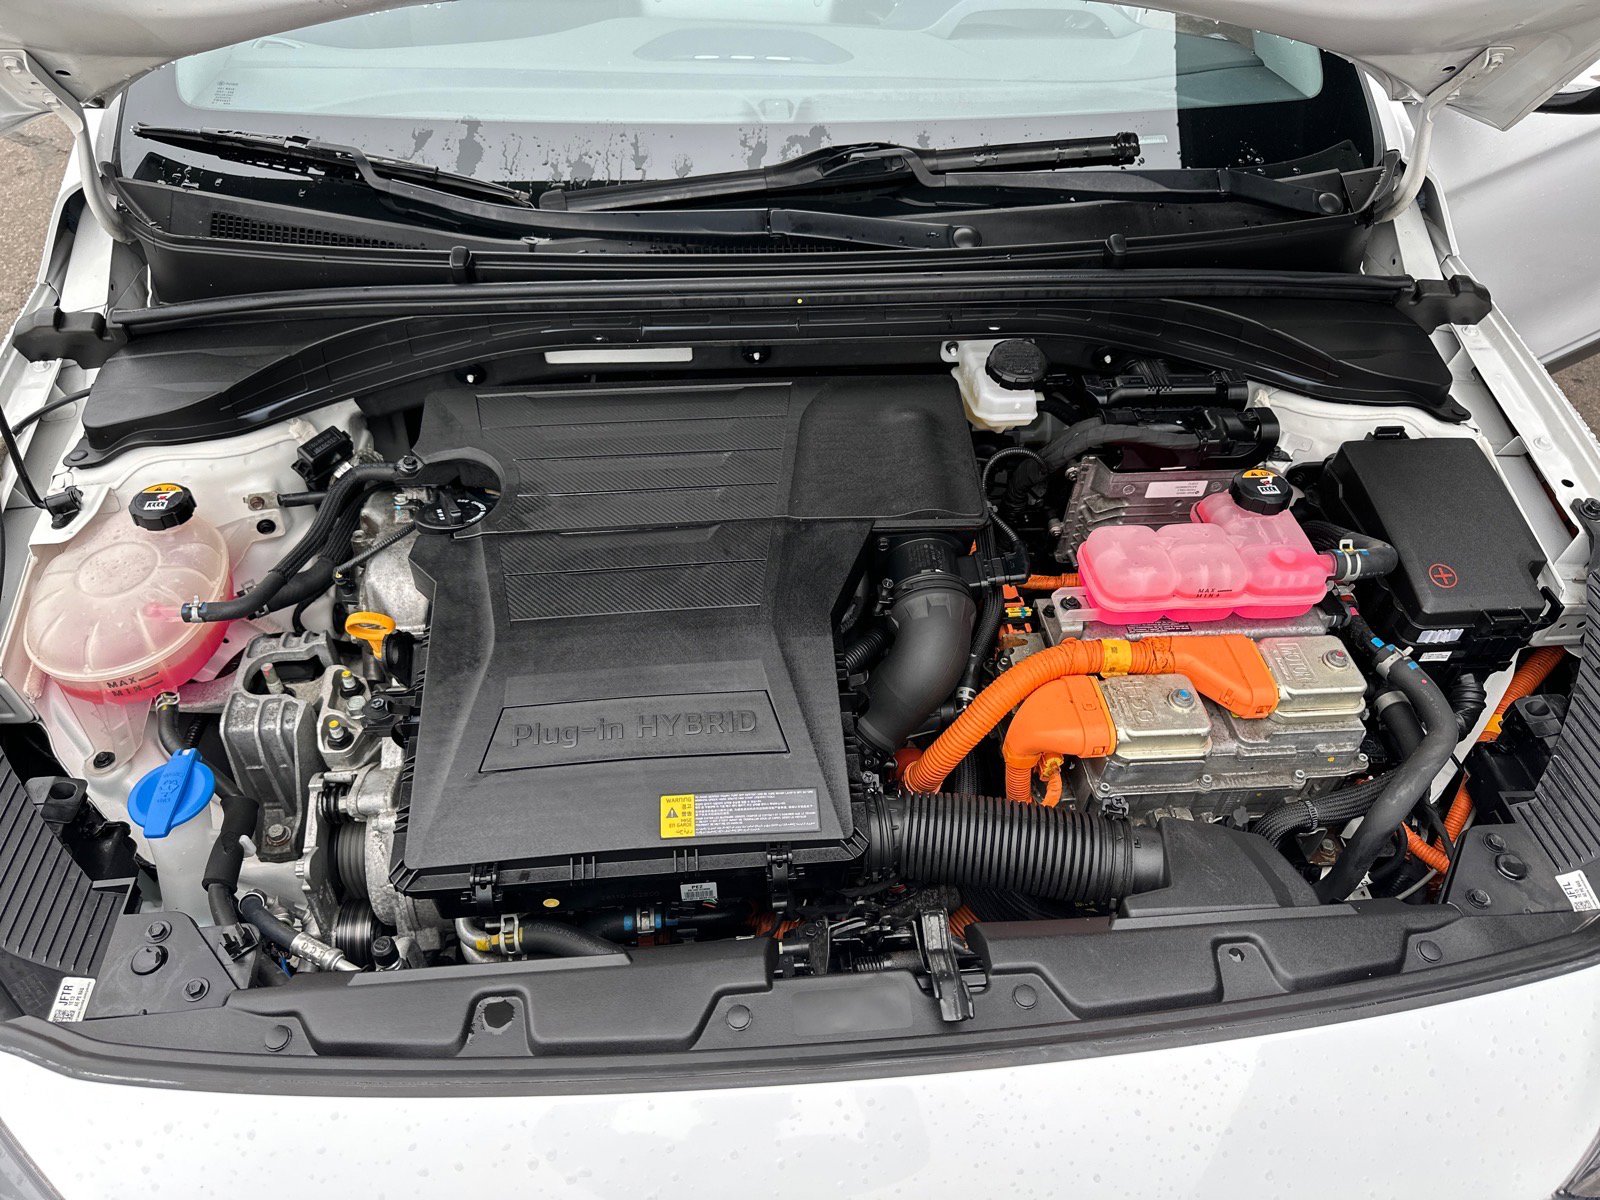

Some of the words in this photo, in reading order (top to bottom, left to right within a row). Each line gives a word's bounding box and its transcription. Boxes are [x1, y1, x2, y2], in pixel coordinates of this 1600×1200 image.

[106, 676, 137, 689] MAX
[111, 685, 142, 697] MIN
[511, 718, 624, 748] Plug-in
[637, 709, 757, 738] HYBRID
[58, 984, 75, 1006] JFTR
